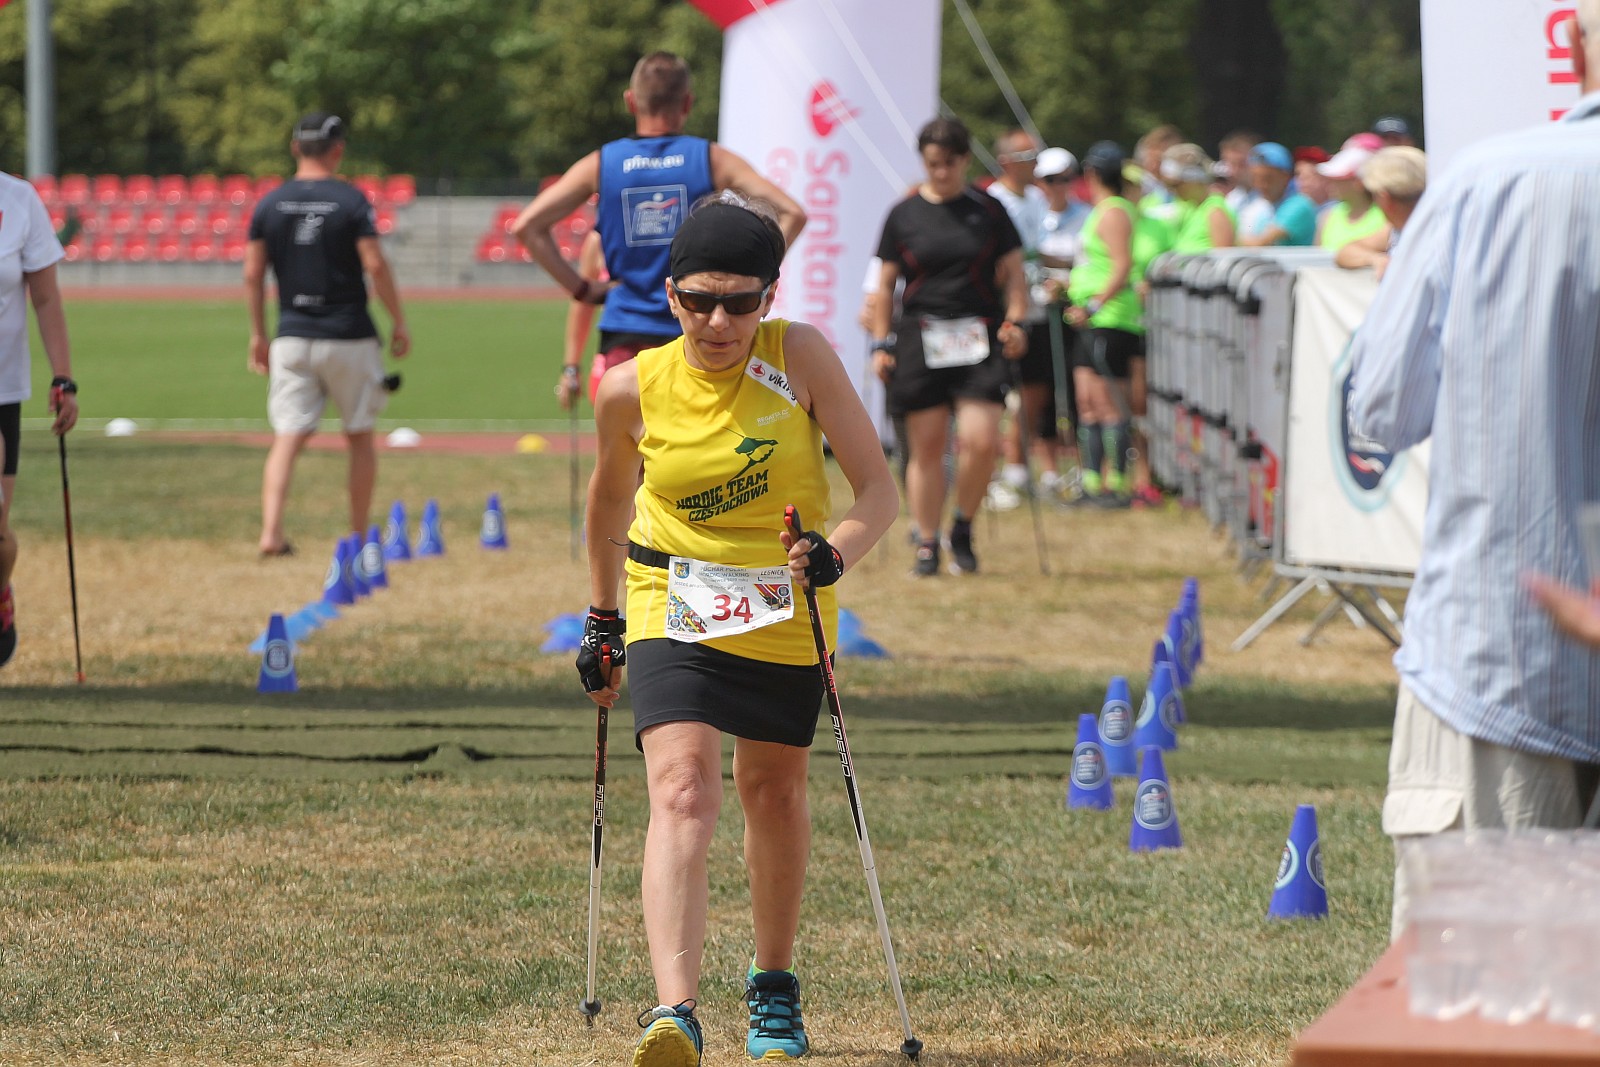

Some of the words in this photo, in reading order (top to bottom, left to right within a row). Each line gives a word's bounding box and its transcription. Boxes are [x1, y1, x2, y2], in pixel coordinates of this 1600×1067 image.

[675, 485, 723, 510] NORDIC
[726, 469, 769, 498] TEAM
[688, 482, 769, 522] CZĘSTOCHOWA
[711, 594, 754, 624] 34
